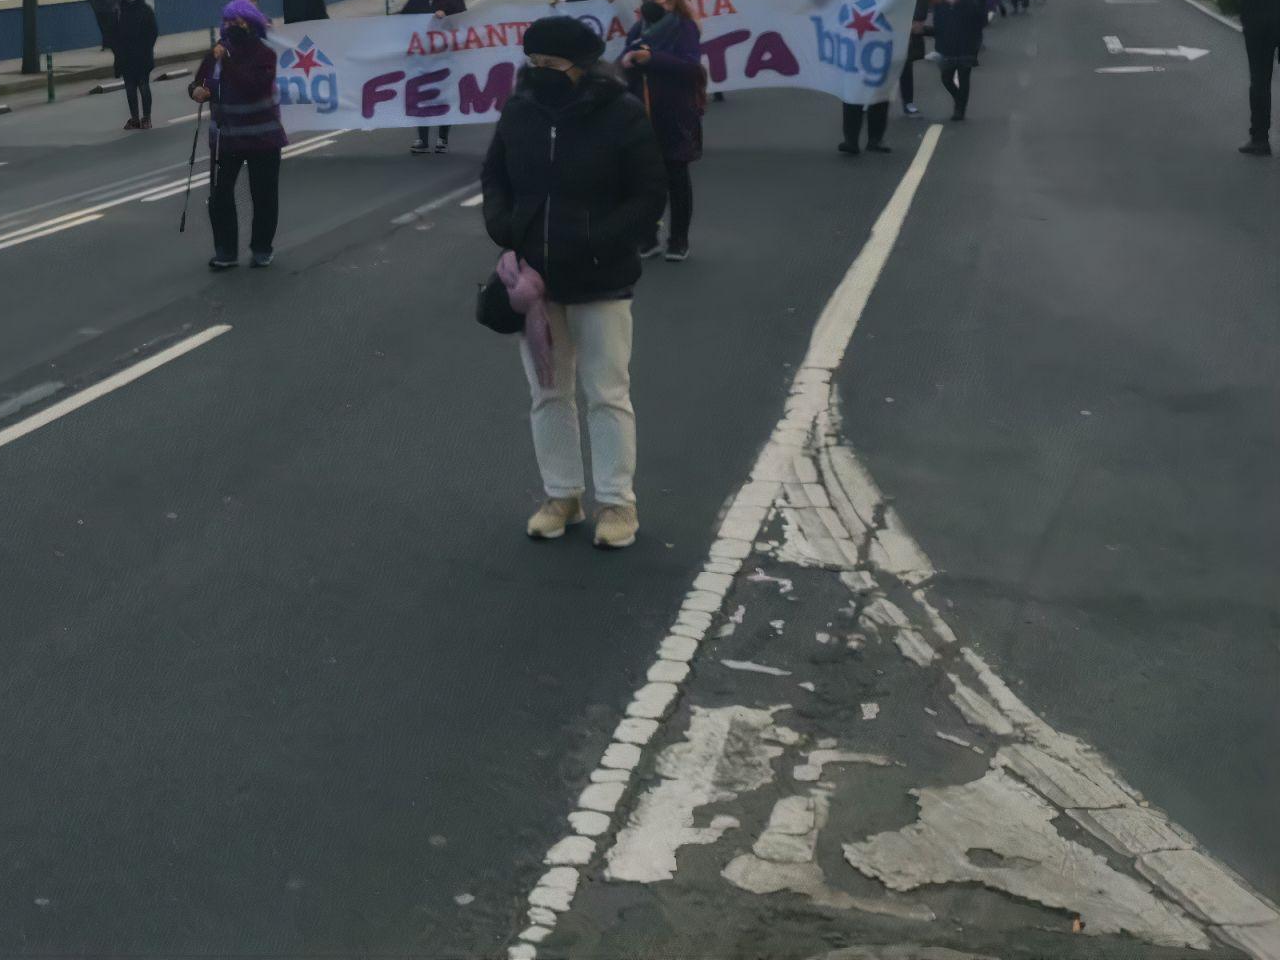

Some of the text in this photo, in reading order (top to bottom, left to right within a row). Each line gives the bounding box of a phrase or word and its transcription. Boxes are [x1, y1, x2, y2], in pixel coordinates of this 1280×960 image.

[407, 21, 532, 56] ADIANT
[810, 14, 894, 88] bng
[275, 73, 339, 114] ng
